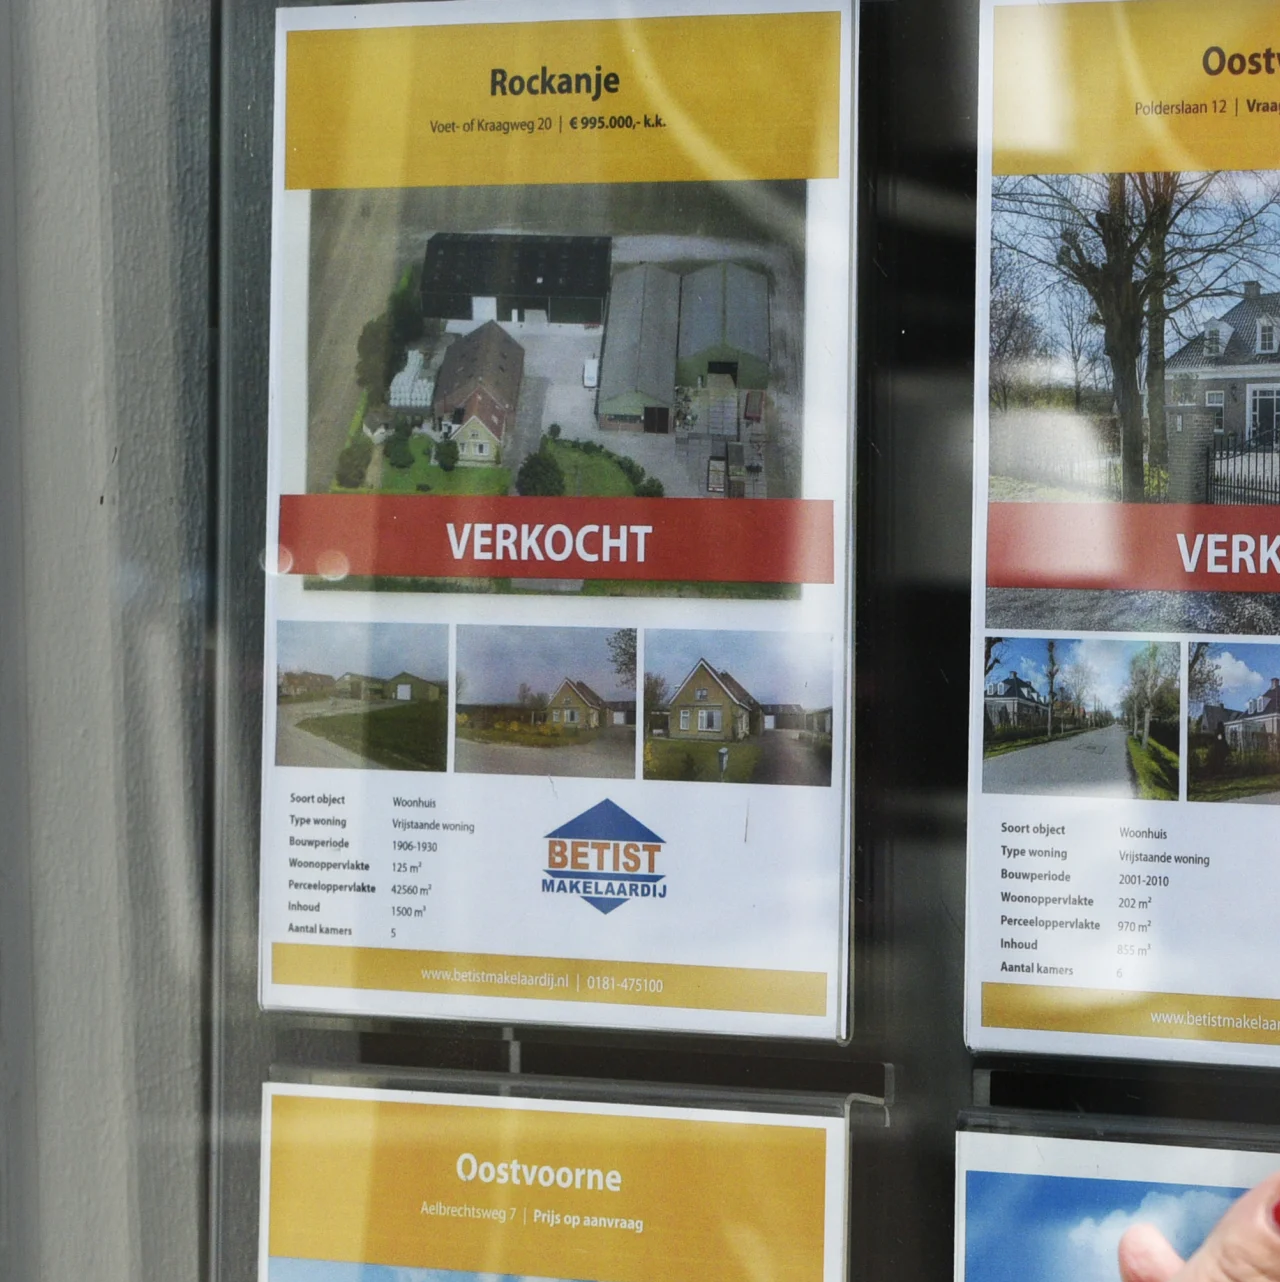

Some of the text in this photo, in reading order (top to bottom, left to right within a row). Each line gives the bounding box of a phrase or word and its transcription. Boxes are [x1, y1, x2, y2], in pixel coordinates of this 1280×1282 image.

[491, 65, 620, 101] Rockanje
[1135, 101, 1208, 116] Polderslaan
[1212, 100, 1227, 113] 12
[431, 120, 459, 133] Voet-
[463, 118, 474, 131] of
[478, 119, 534, 133] Kraagweg
[538, 118, 552, 130] 20
[644, 115, 666, 128] k.k.
[446, 523, 652, 562] VERKOCHT
[290, 794, 345, 806] Soort object
[393, 797, 436, 808] Woonhuis
[290, 815, 346, 828] Type woning
[393, 819, 475, 833] Vrijstaande woning
[1001, 823, 1065, 837] Soort object
[1120, 827, 1167, 839] Woonhuis
[289, 837, 349, 849] Bouwperiode
[393, 841, 437, 852] 1906-1930
[548, 840, 661, 873] BETIST
[1001, 846, 1067, 860] Type woning
[1120, 850, 1210, 867] Vrijstaande woning
[289, 858, 370, 871] Woonoppervlakte
[393, 863, 407, 872] 125
[1001, 869, 1070, 882] Bouwperiode
[1119, 874, 1169, 886] 2001-2010
[289, 880, 375, 893] Perceeloppervlakte
[391, 885, 418, 894] 42560
[542, 879, 667, 898] MAKELAARDIJ
[1001, 892, 1093, 906] Woonoppervlakte
[1119, 898, 1136, 908] 202
[288, 902, 320, 912] Inhoud
[392, 906, 412, 916] 1500
[288, 923, 352, 935] Aantal kamers
[1001, 915, 1100, 930] Perceeloppervlakte
[1118, 921, 1136, 931] 970
[391, 928, 396, 938] 5
[1001, 939, 1037, 950] Inhoud
[1001, 962, 1073, 975] Aantal kamers
[422, 968, 662, 992] www.betistmakelaardij.nl 0181-475100
[456, 1153, 622, 1191] Oostvoorne
[421, 1202, 643, 1233] Aelbrechtsweg 7 Prijs op aanvraag
